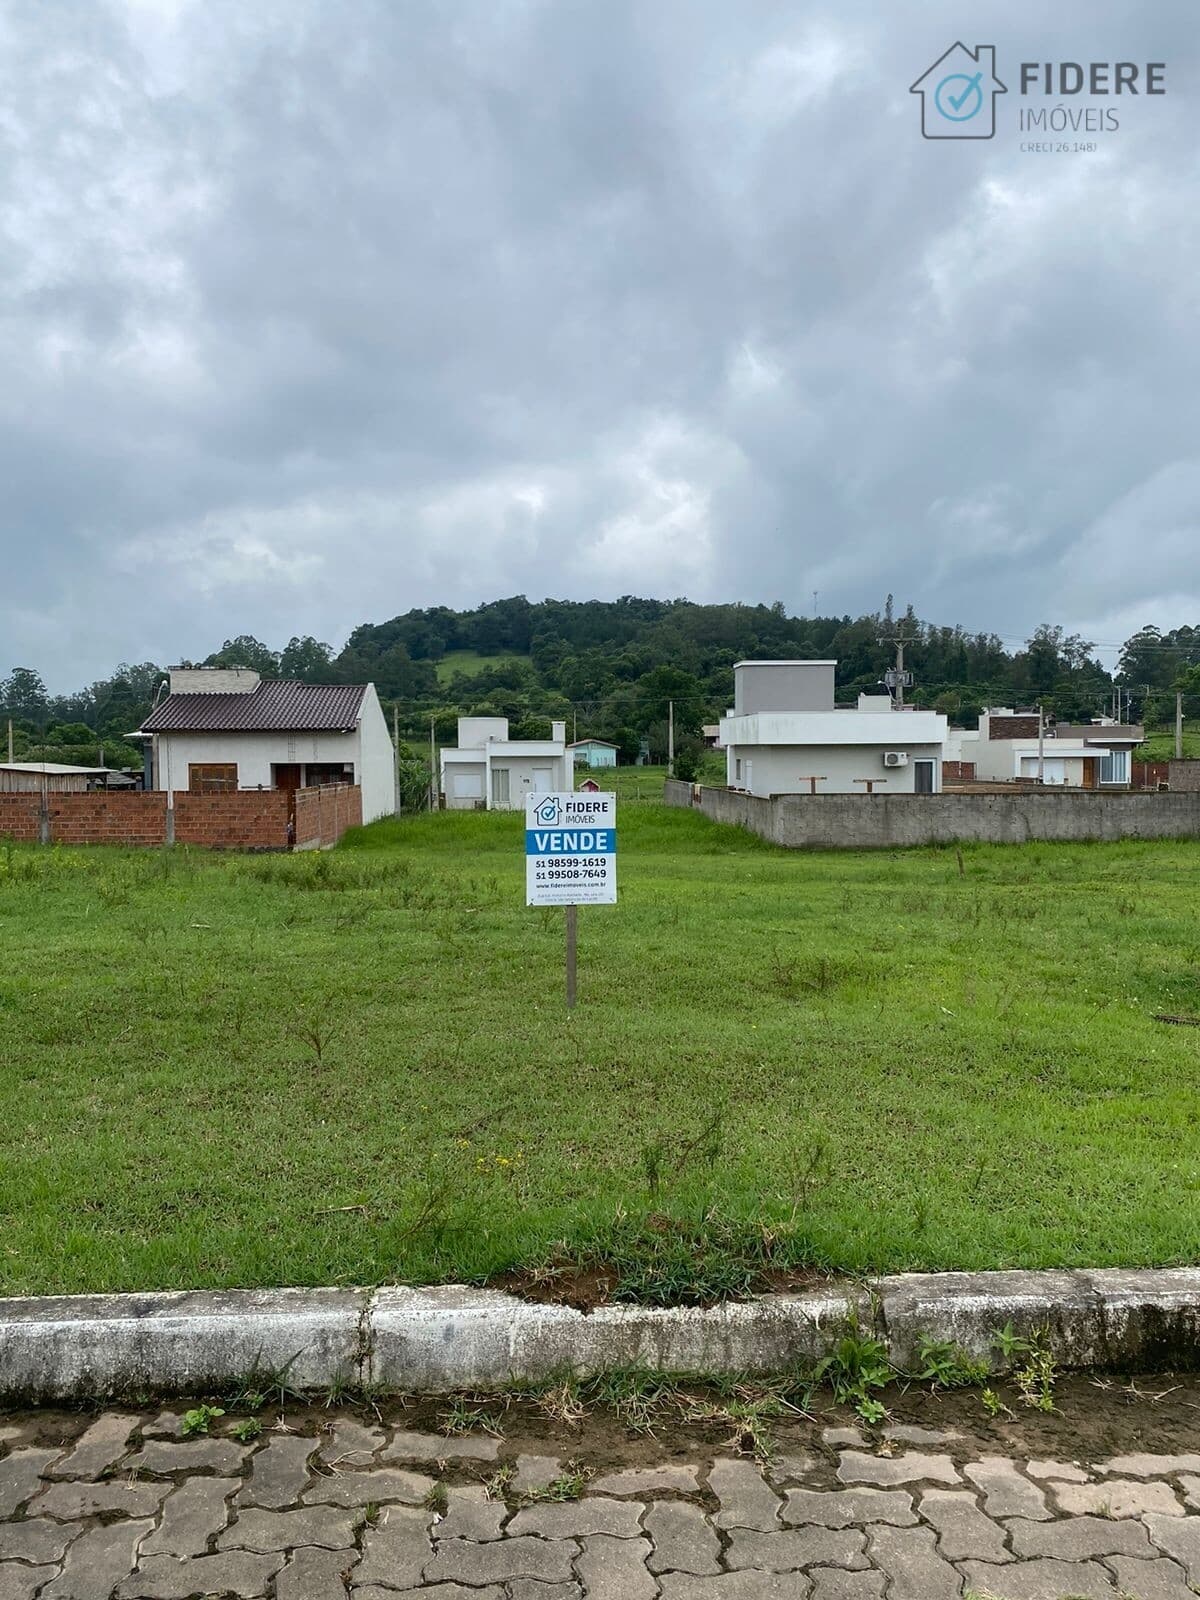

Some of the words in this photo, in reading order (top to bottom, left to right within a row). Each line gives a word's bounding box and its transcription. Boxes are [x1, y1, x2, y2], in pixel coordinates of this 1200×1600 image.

[566, 802, 608, 813] FIDERE
[565, 814, 595, 824] IMÓVEIS
[534, 832, 608, 851] VENDE
[536, 860, 546, 868] 51
[548, 858, 606, 868] 98599-1619
[536, 872, 546, 880] 51
[548, 869, 606, 879] 99508-7649
